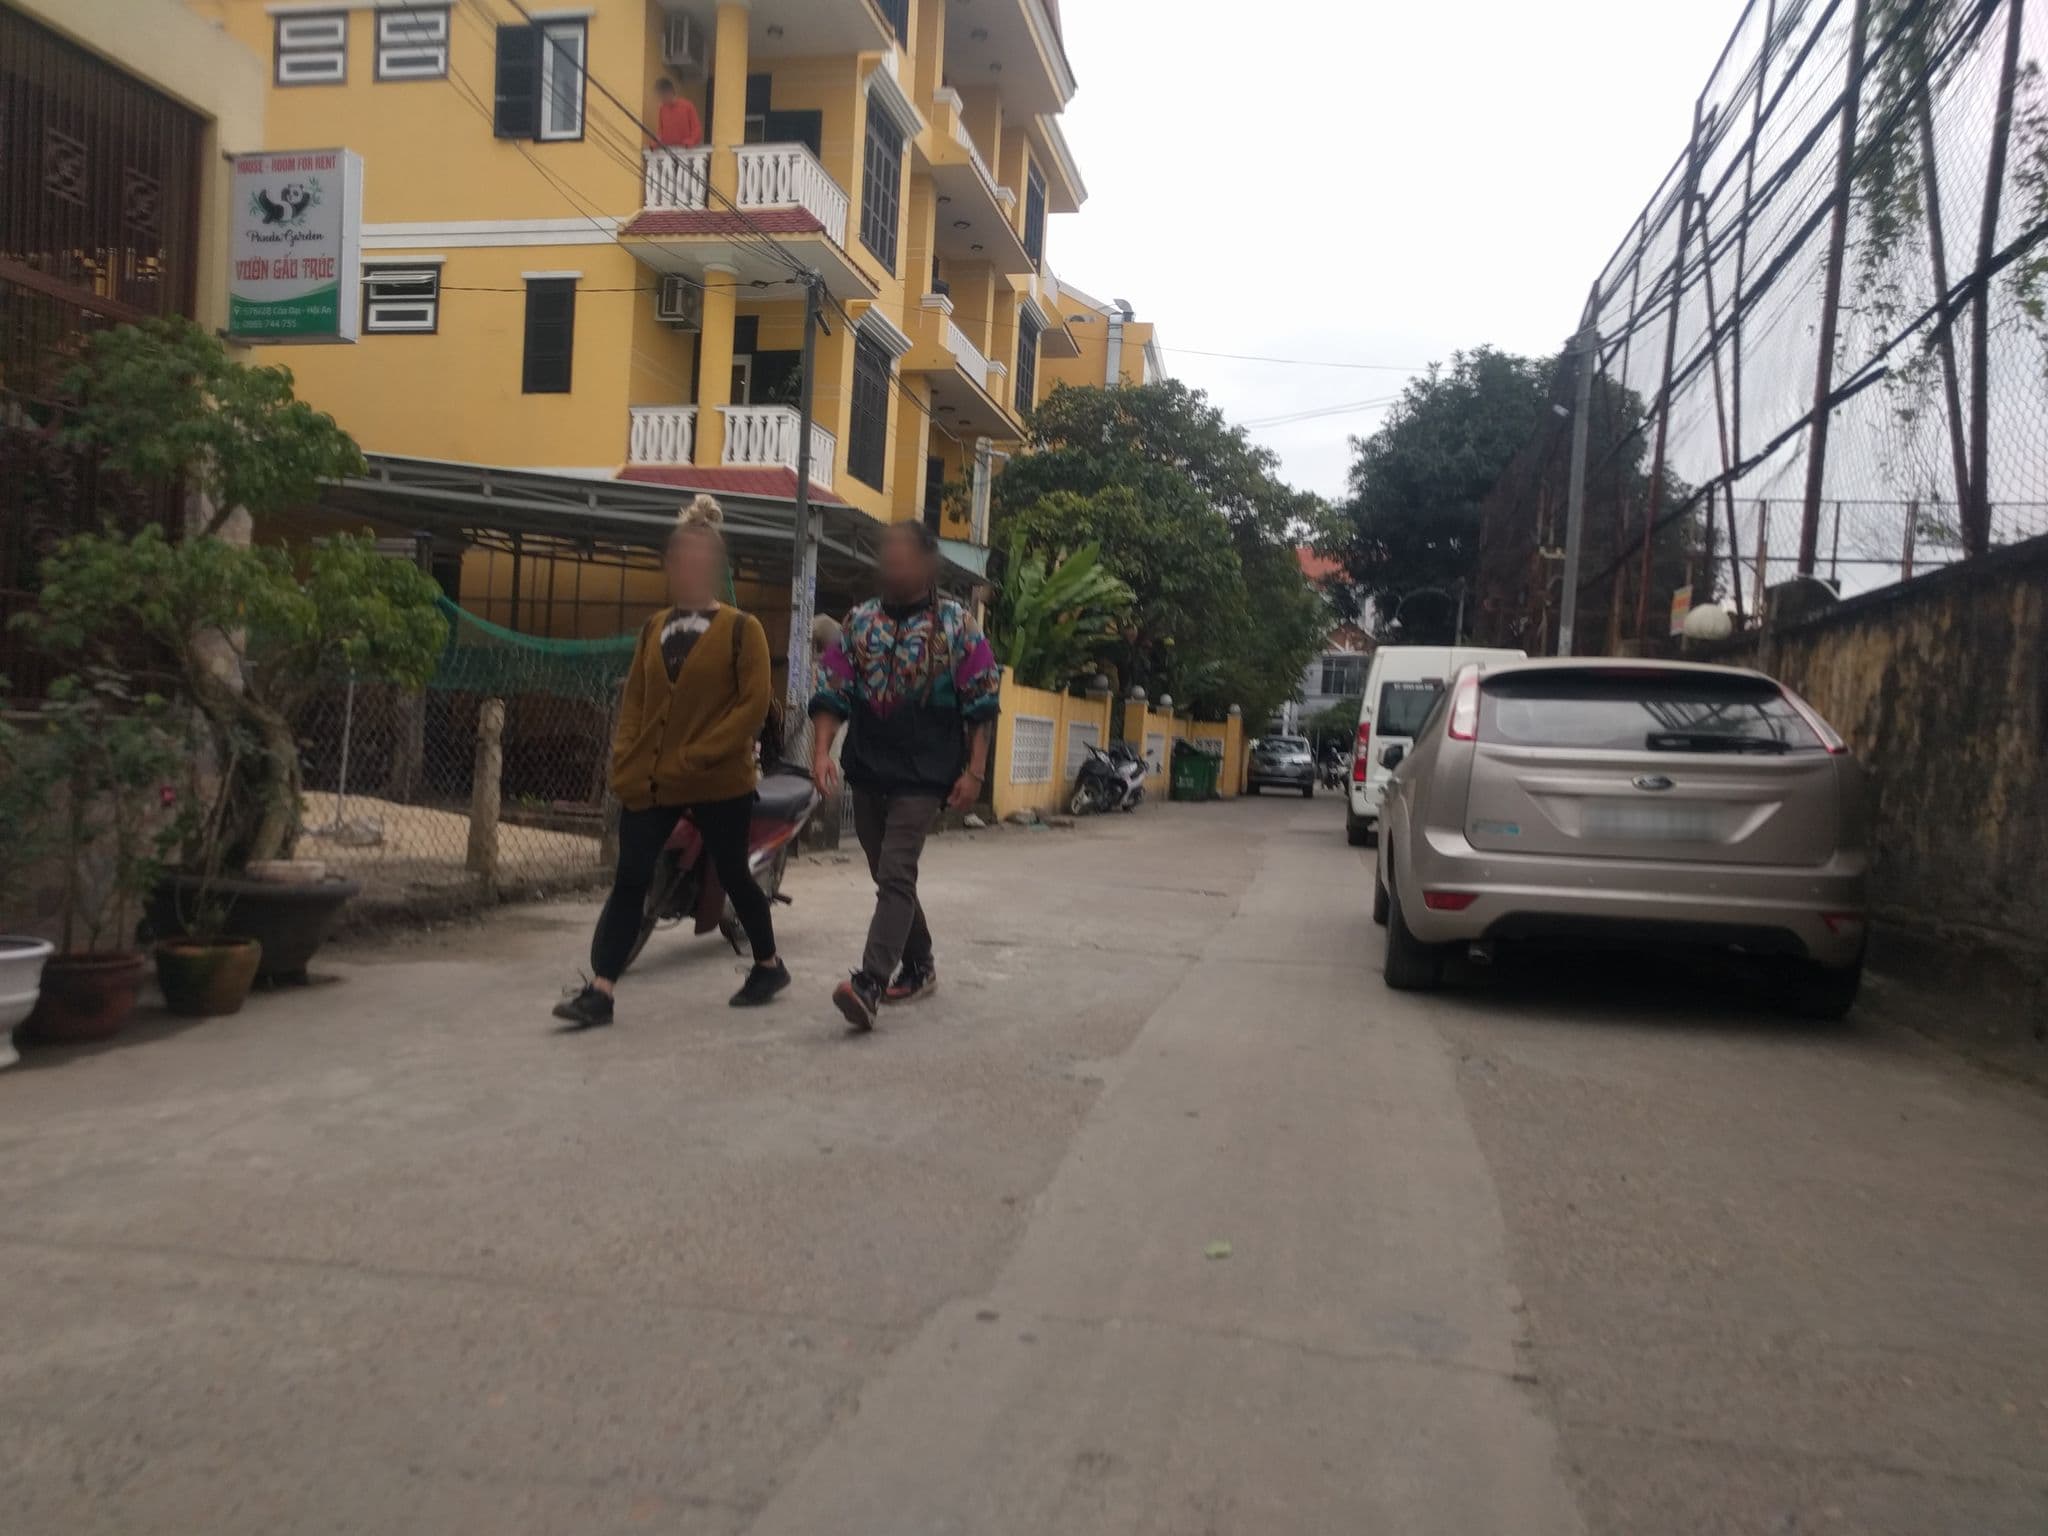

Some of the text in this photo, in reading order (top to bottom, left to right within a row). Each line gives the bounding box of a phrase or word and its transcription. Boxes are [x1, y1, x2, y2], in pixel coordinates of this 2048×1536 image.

[237, 159, 263, 174] HOUSE
[271, 156, 296, 172] ROOM
[297, 155, 314, 171] FOR
[315, 154, 337, 170] RENT
[246, 228, 325, 247] Panda Garden
[302, 252, 335, 280] TRÚC
